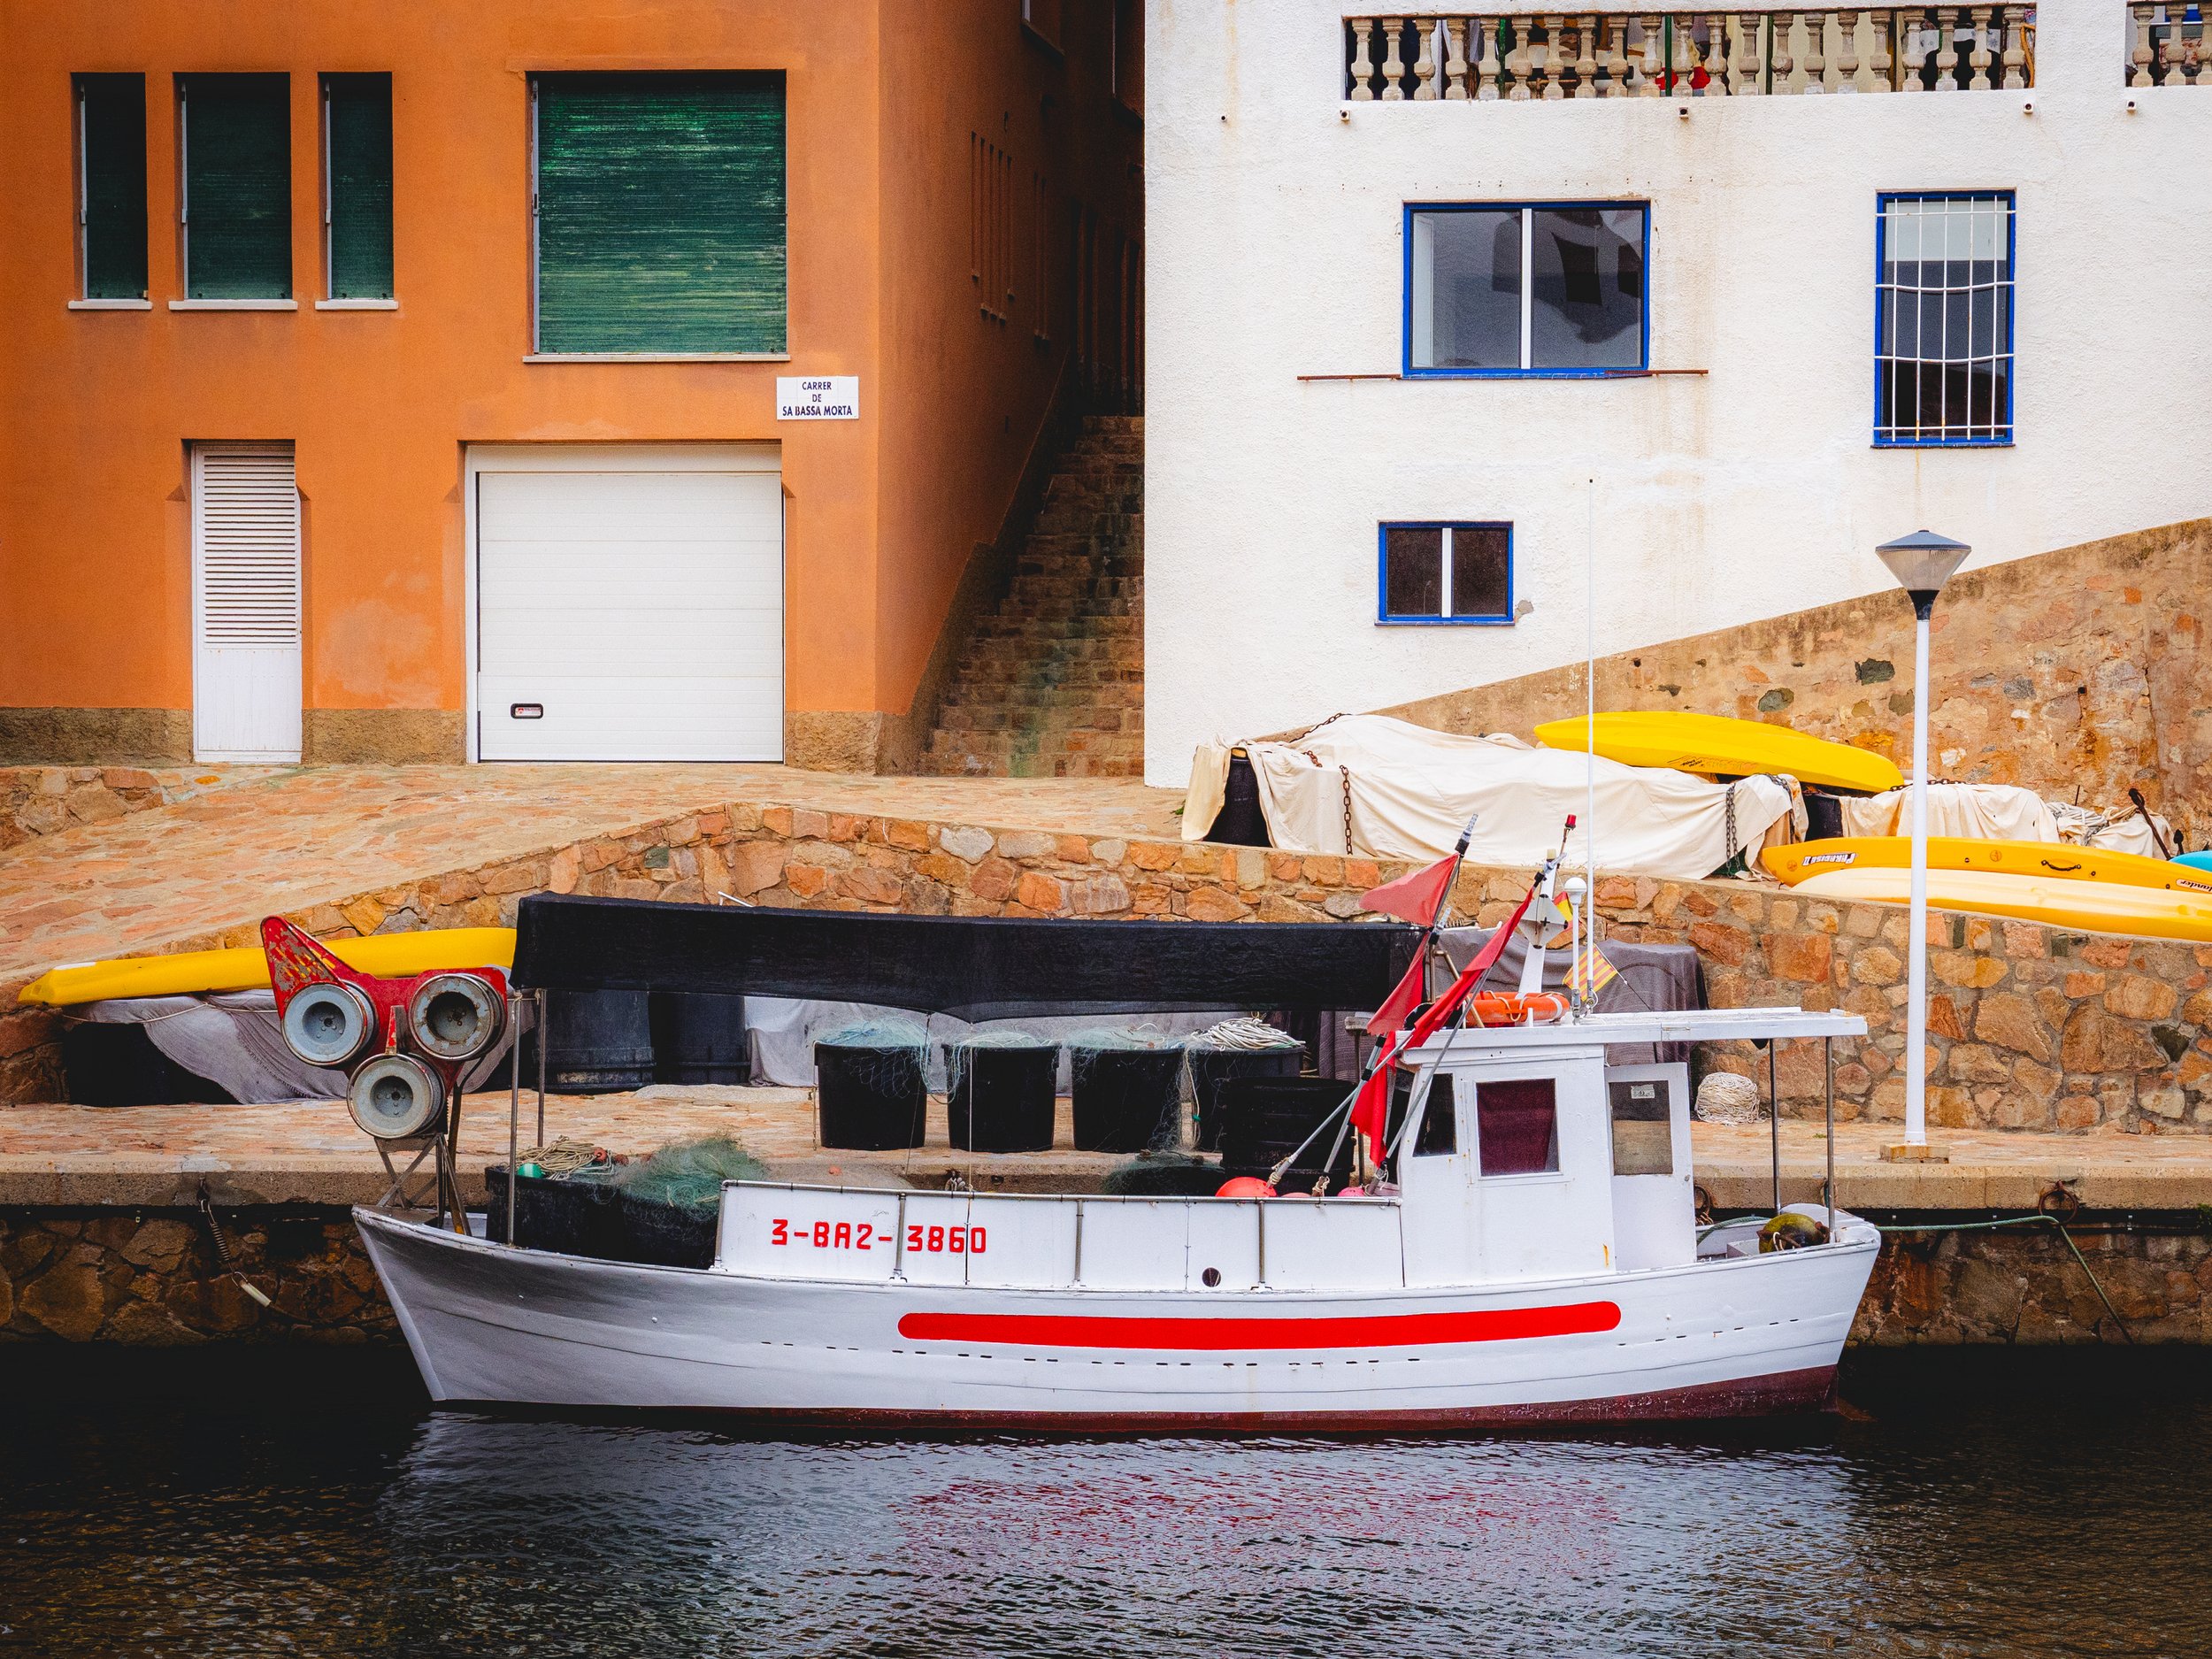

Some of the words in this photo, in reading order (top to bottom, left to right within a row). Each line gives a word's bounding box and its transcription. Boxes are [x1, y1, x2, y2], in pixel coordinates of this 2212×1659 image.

[802, 381, 832, 390] CARRER
[811, 394, 822, 403] DE
[782, 406, 793, 416] SA
[795, 406, 821, 416] BASSA
[823, 405, 852, 416] MORTA
